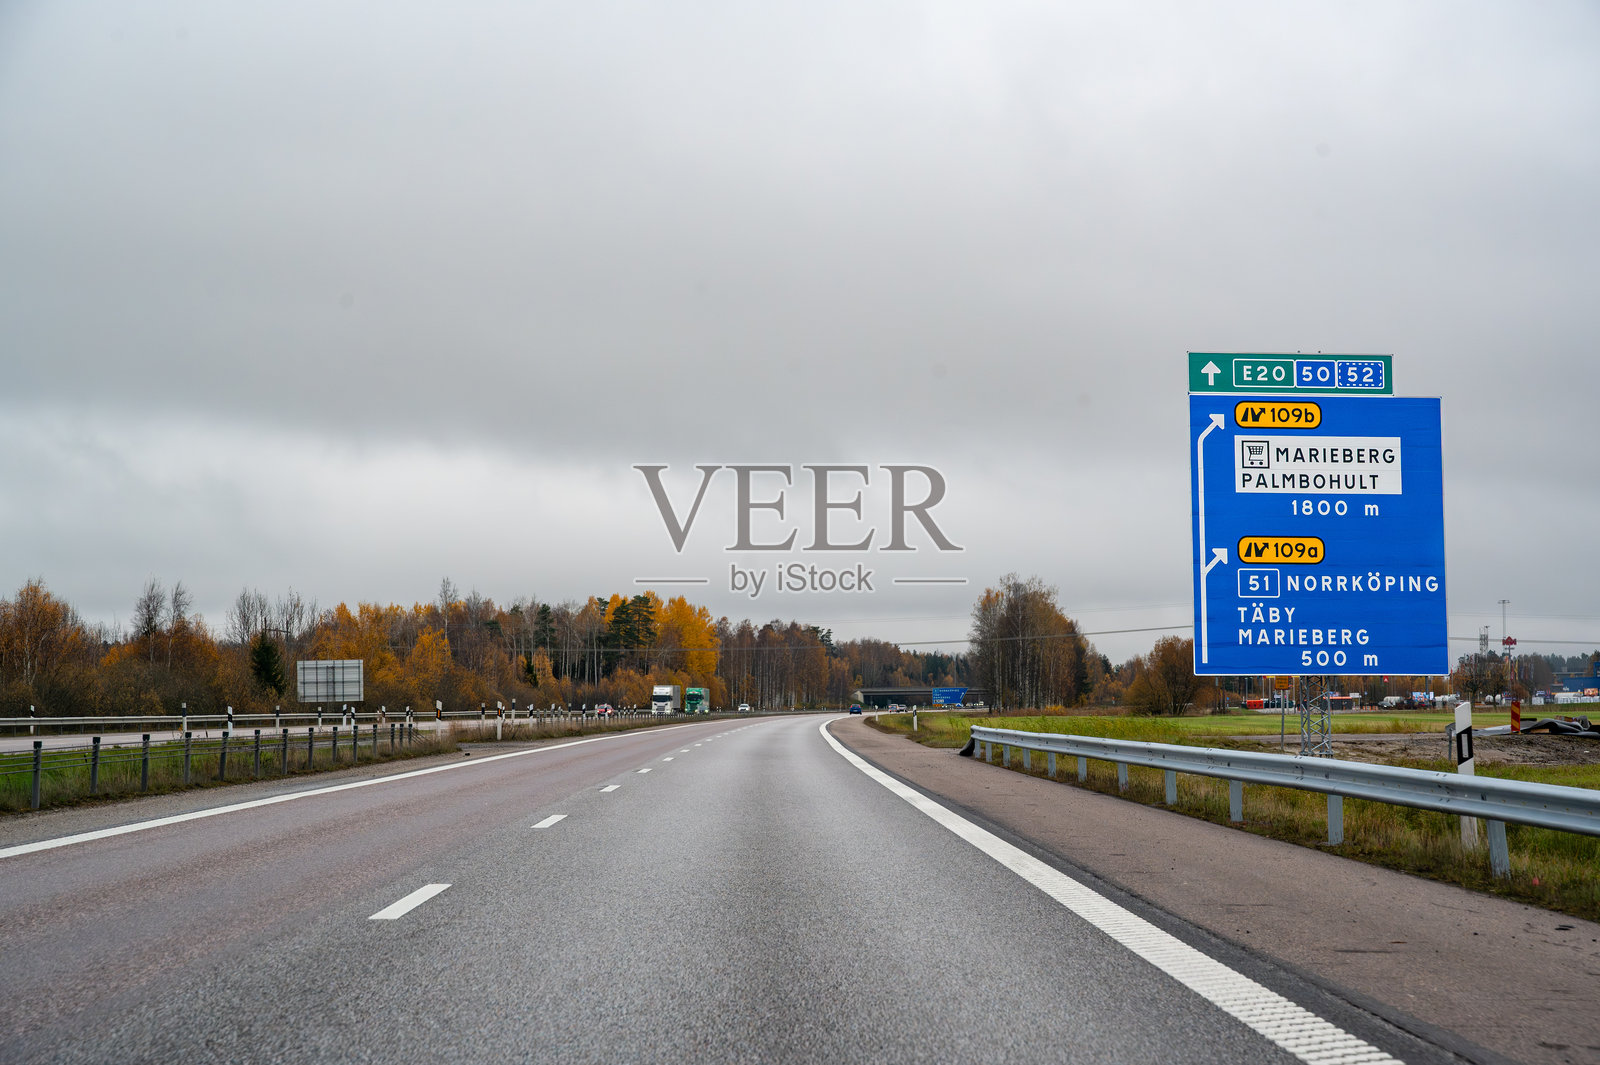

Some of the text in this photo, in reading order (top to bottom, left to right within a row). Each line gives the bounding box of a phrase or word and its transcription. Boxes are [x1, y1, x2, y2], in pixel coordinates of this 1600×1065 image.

[1243, 365, 1285, 382] E20
[1302, 366, 1330, 382] 50
[1347, 366, 1374, 383] 52
[1270, 407, 1315, 424] 109b
[1276, 447, 1395, 464] MARIEBERG
[1242, 473, 1379, 490] PALMBOHULT
[1291, 500, 1379, 516] 1800 m
[1273, 542, 1318, 559] 109a
[1248, 575, 1270, 591] 51
[1287, 572, 1439, 593] NORRKÖPING
[1237, 602, 1296, 623] TÄBY
[1238, 628, 1370, 645] MARIEBERG
[1301, 651, 1379, 667] 500 m
